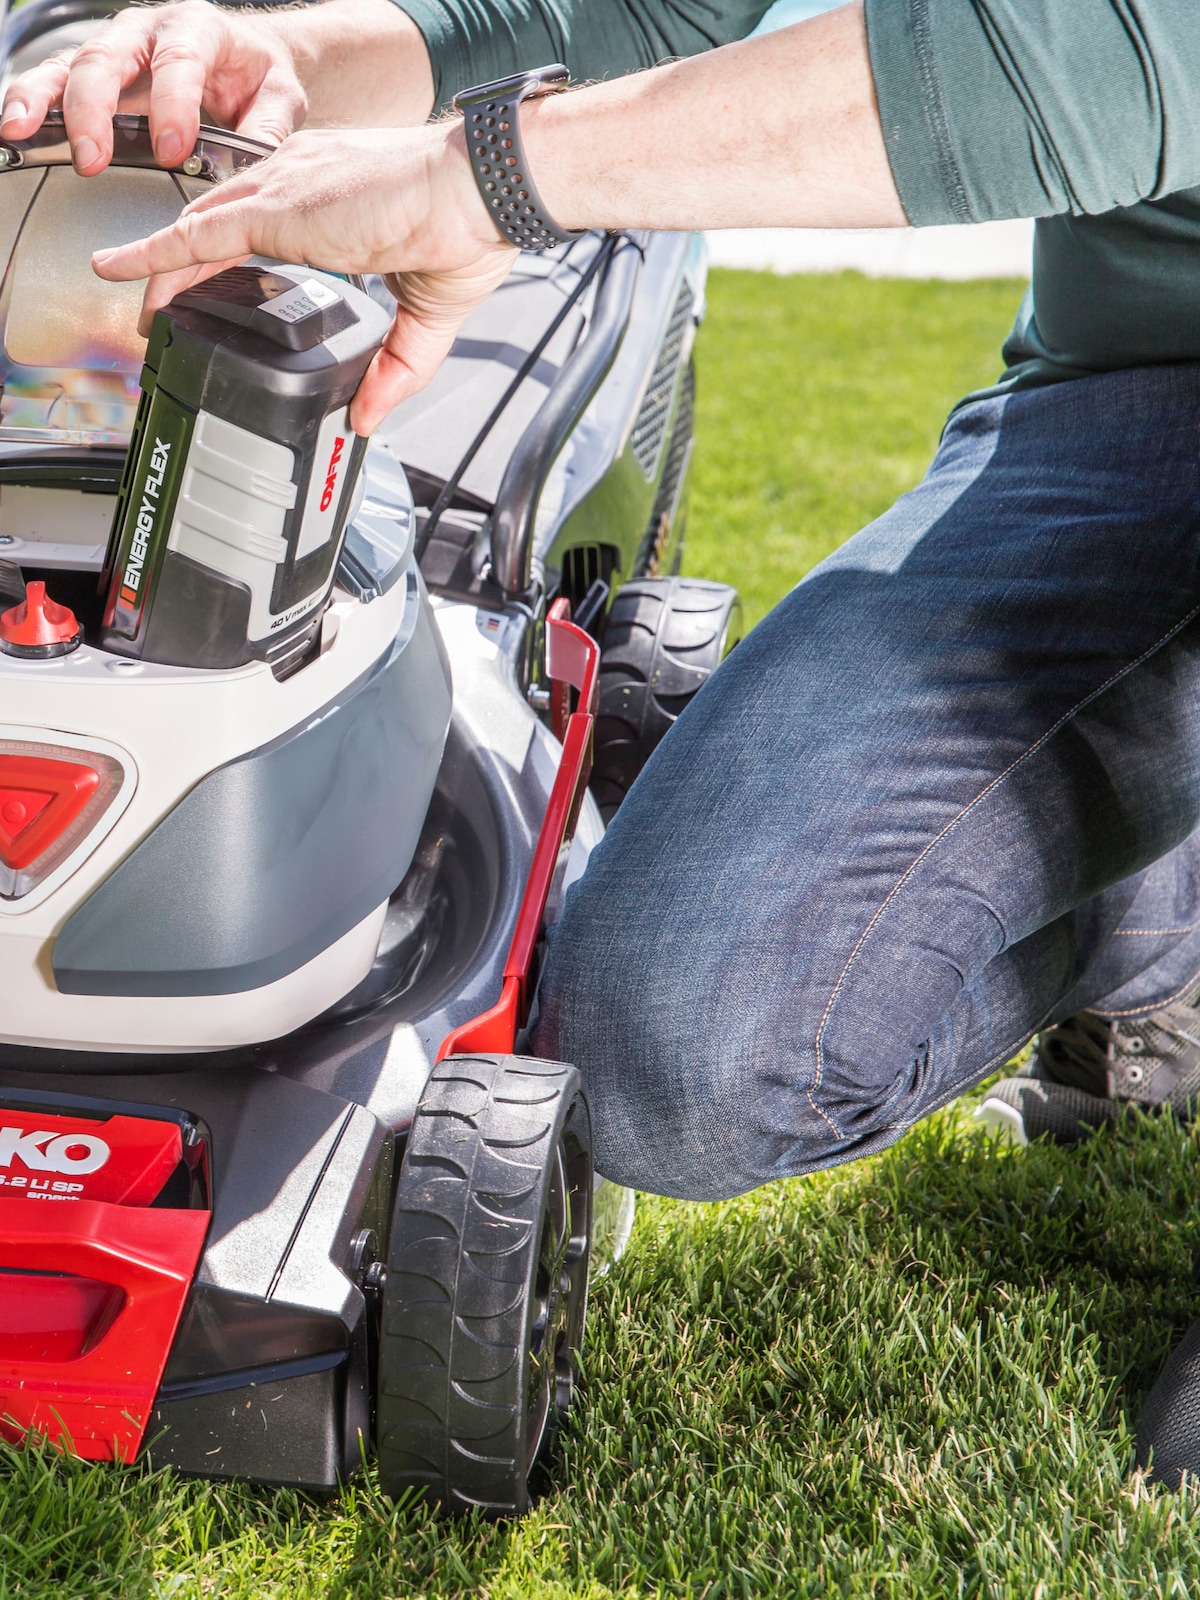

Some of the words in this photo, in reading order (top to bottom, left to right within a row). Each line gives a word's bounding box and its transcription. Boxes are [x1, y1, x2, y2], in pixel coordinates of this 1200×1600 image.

[319, 436, 345, 512] AL-KO
[123, 496, 156, 590] ENERGY
[144, 437, 172, 499] FLEX
[270, 617, 284, 629] 40
[285, 612, 292, 622] V
[29, 1178, 50, 1191] Li
[51, 1180, 84, 1193] SP
